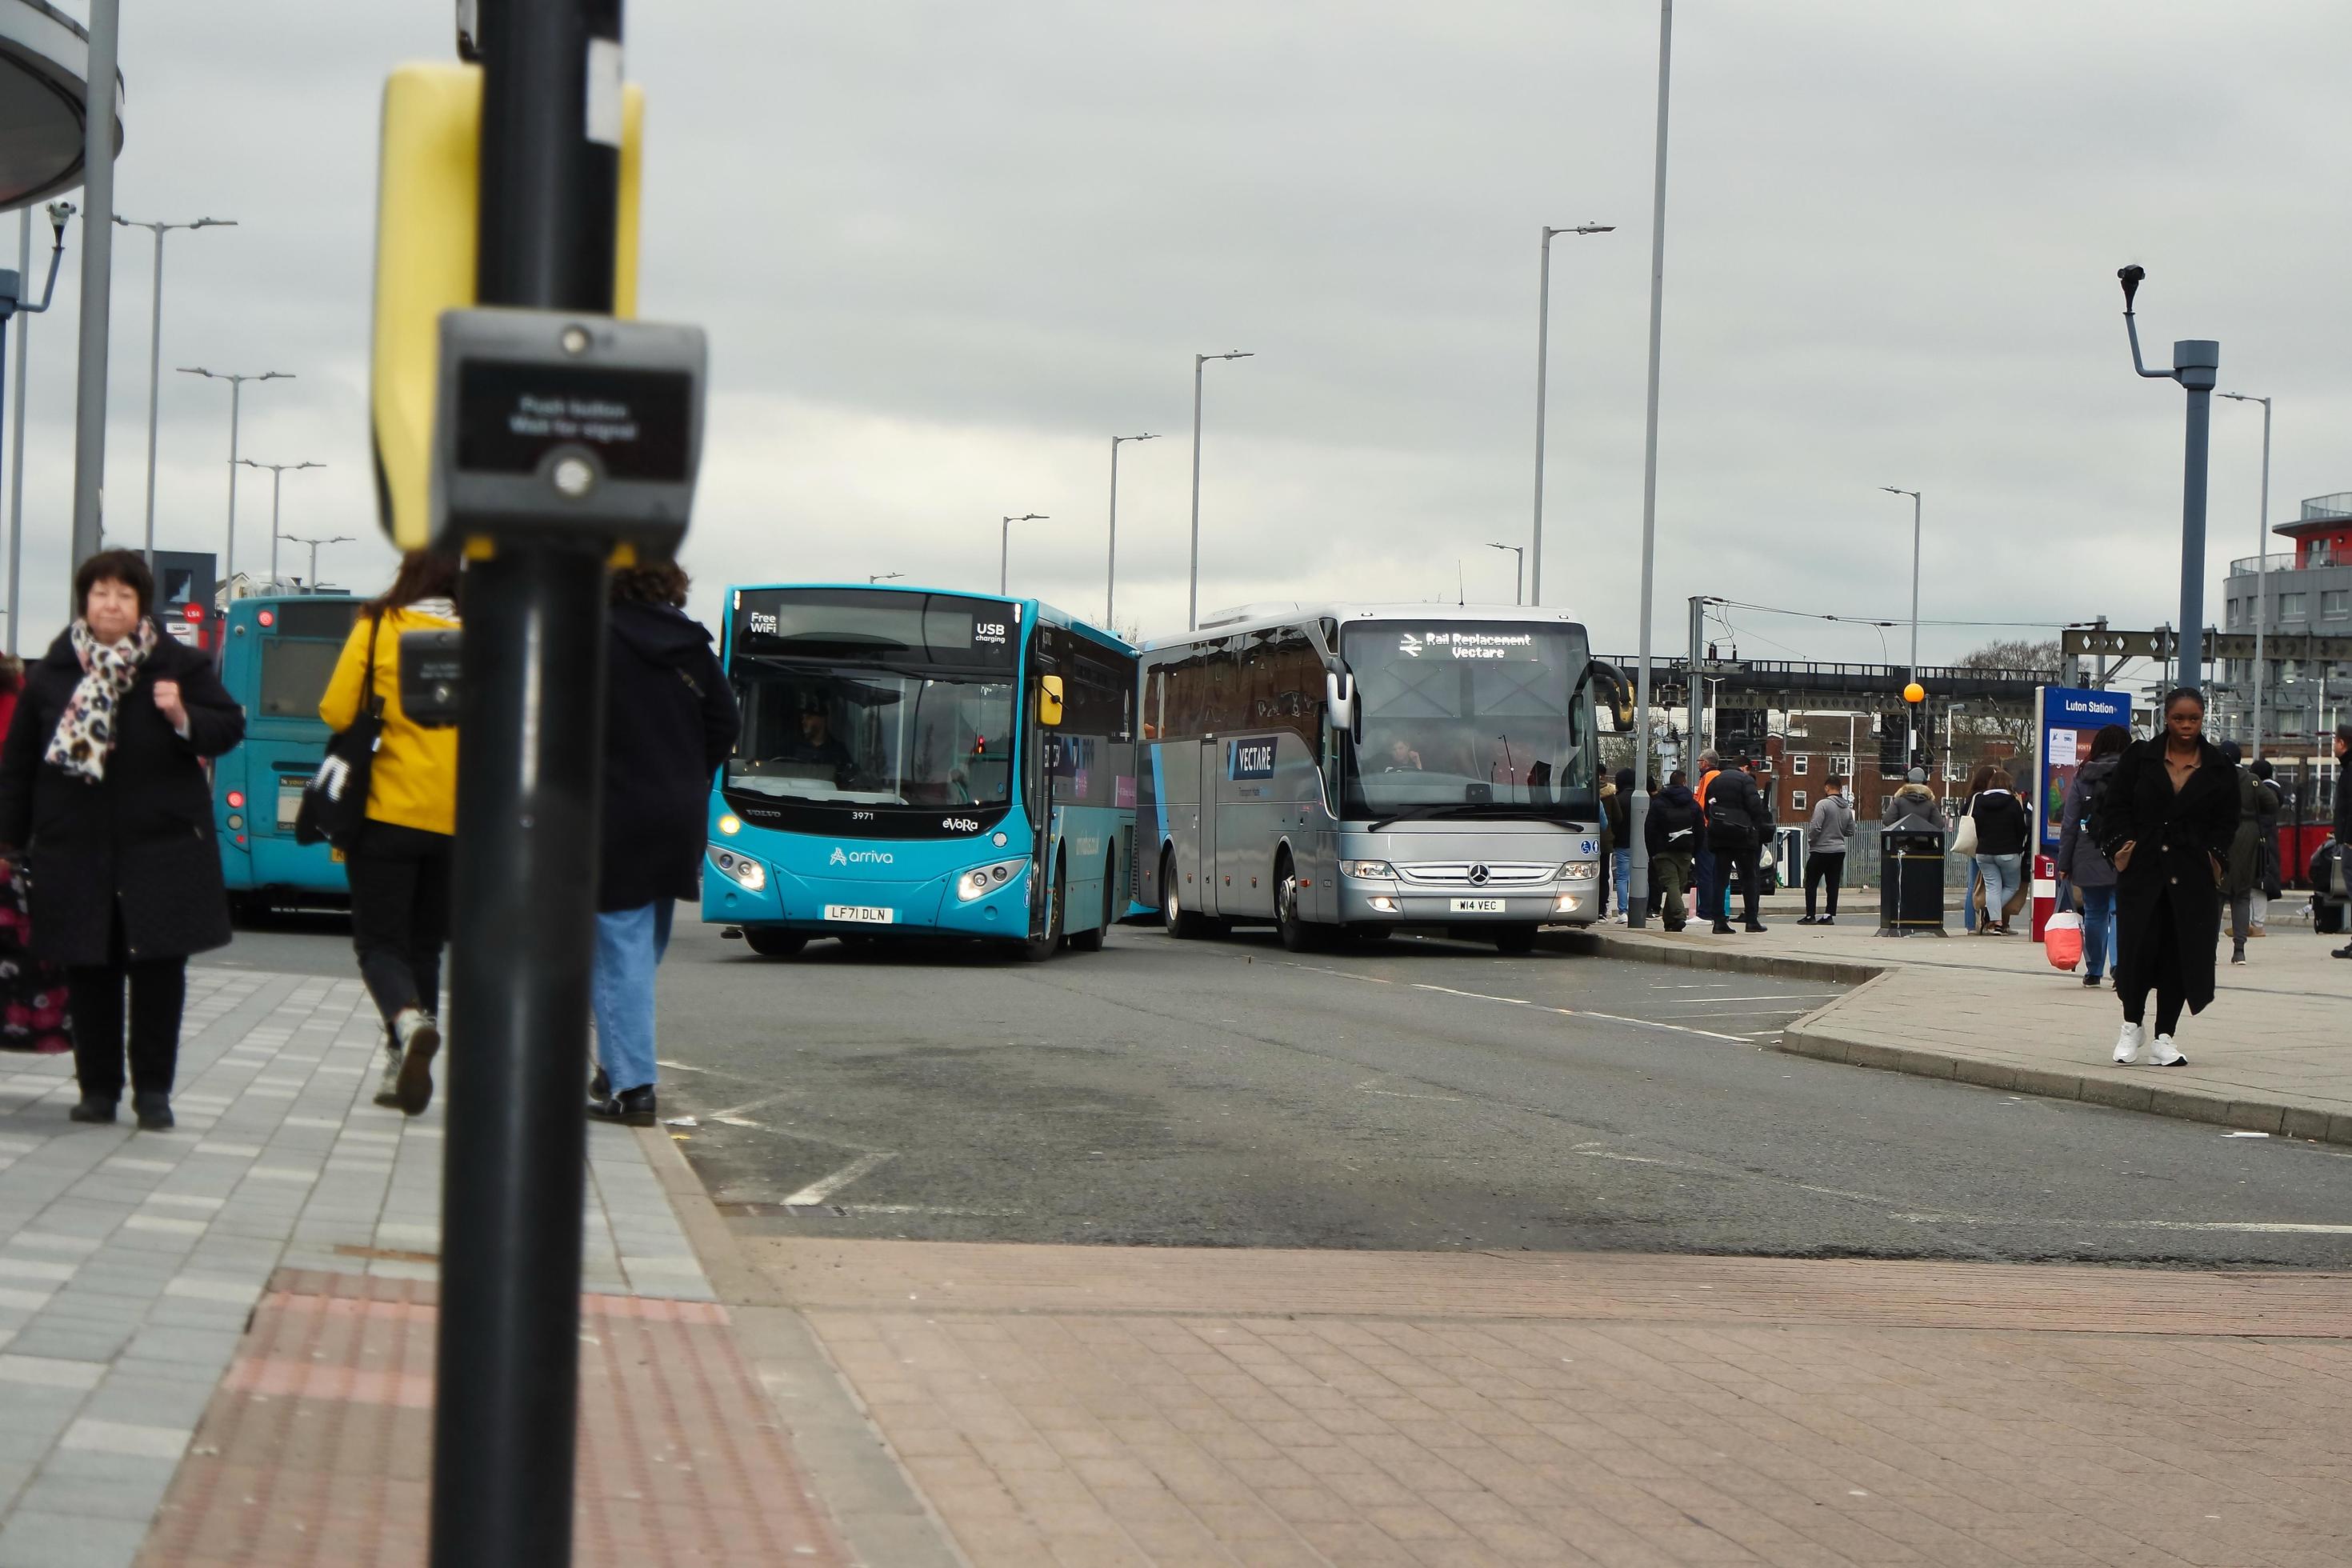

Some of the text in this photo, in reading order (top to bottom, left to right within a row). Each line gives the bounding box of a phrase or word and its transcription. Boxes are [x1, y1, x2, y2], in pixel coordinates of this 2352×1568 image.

[751, 612, 776, 623] Free
[750, 622, 777, 634] WiFi
[976, 623, 1005, 636] USB
[975, 634, 1006, 645] charging
[1426, 633, 1532, 646] Rail Replacement
[1452, 646, 1505, 659] Vectare
[2066, 699, 2114, 714] Luton Station
[1238, 746, 1271, 772] VECTARE
[746, 809, 782, 818] VOLVO
[852, 811, 874, 820] 3971
[849, 850, 894, 864] arriva
[1478, 900, 1497, 910] VEC
[831, 906, 886, 921] LF71 DLN
